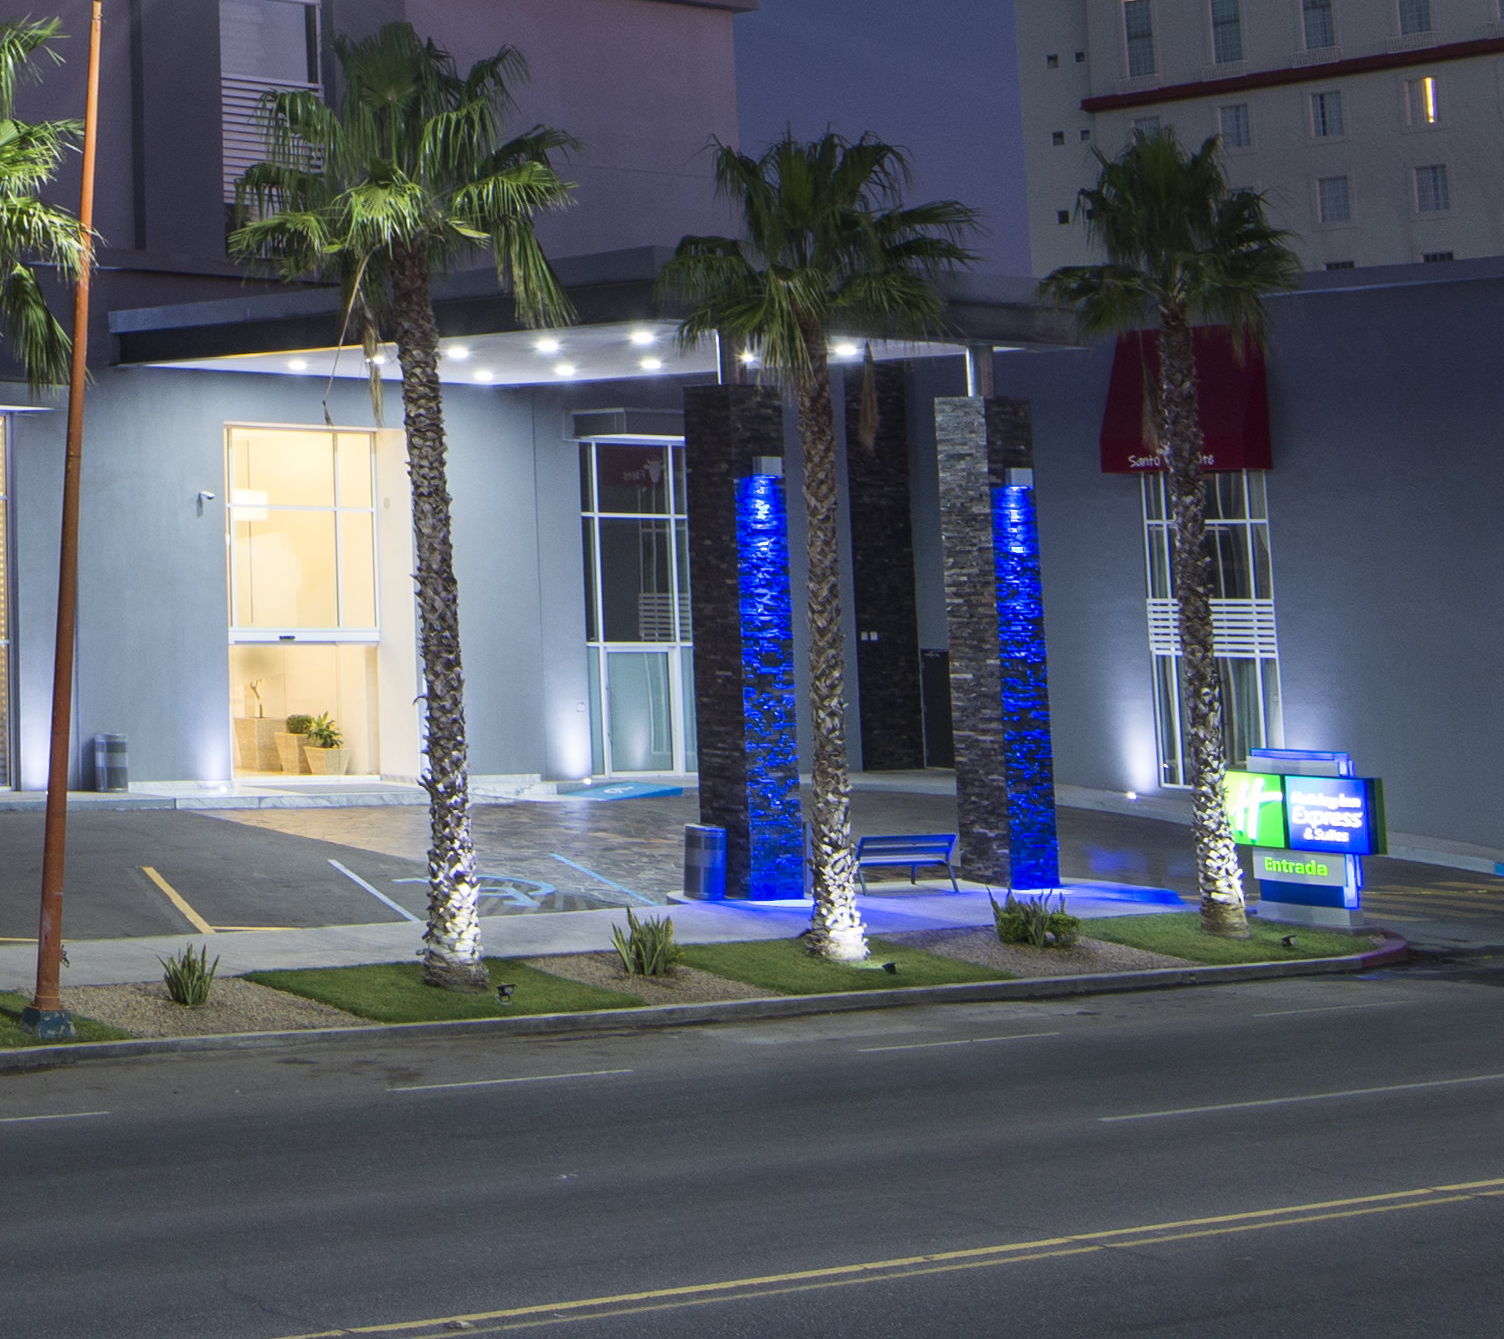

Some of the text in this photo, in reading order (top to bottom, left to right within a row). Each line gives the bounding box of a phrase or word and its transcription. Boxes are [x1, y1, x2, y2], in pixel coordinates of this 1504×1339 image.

[1128, 454, 1161, 469] Santo
[1291, 805, 1363, 829] Express
[1313, 827, 1350, 843] Suites
[1263, 856, 1328, 877] Entrada
